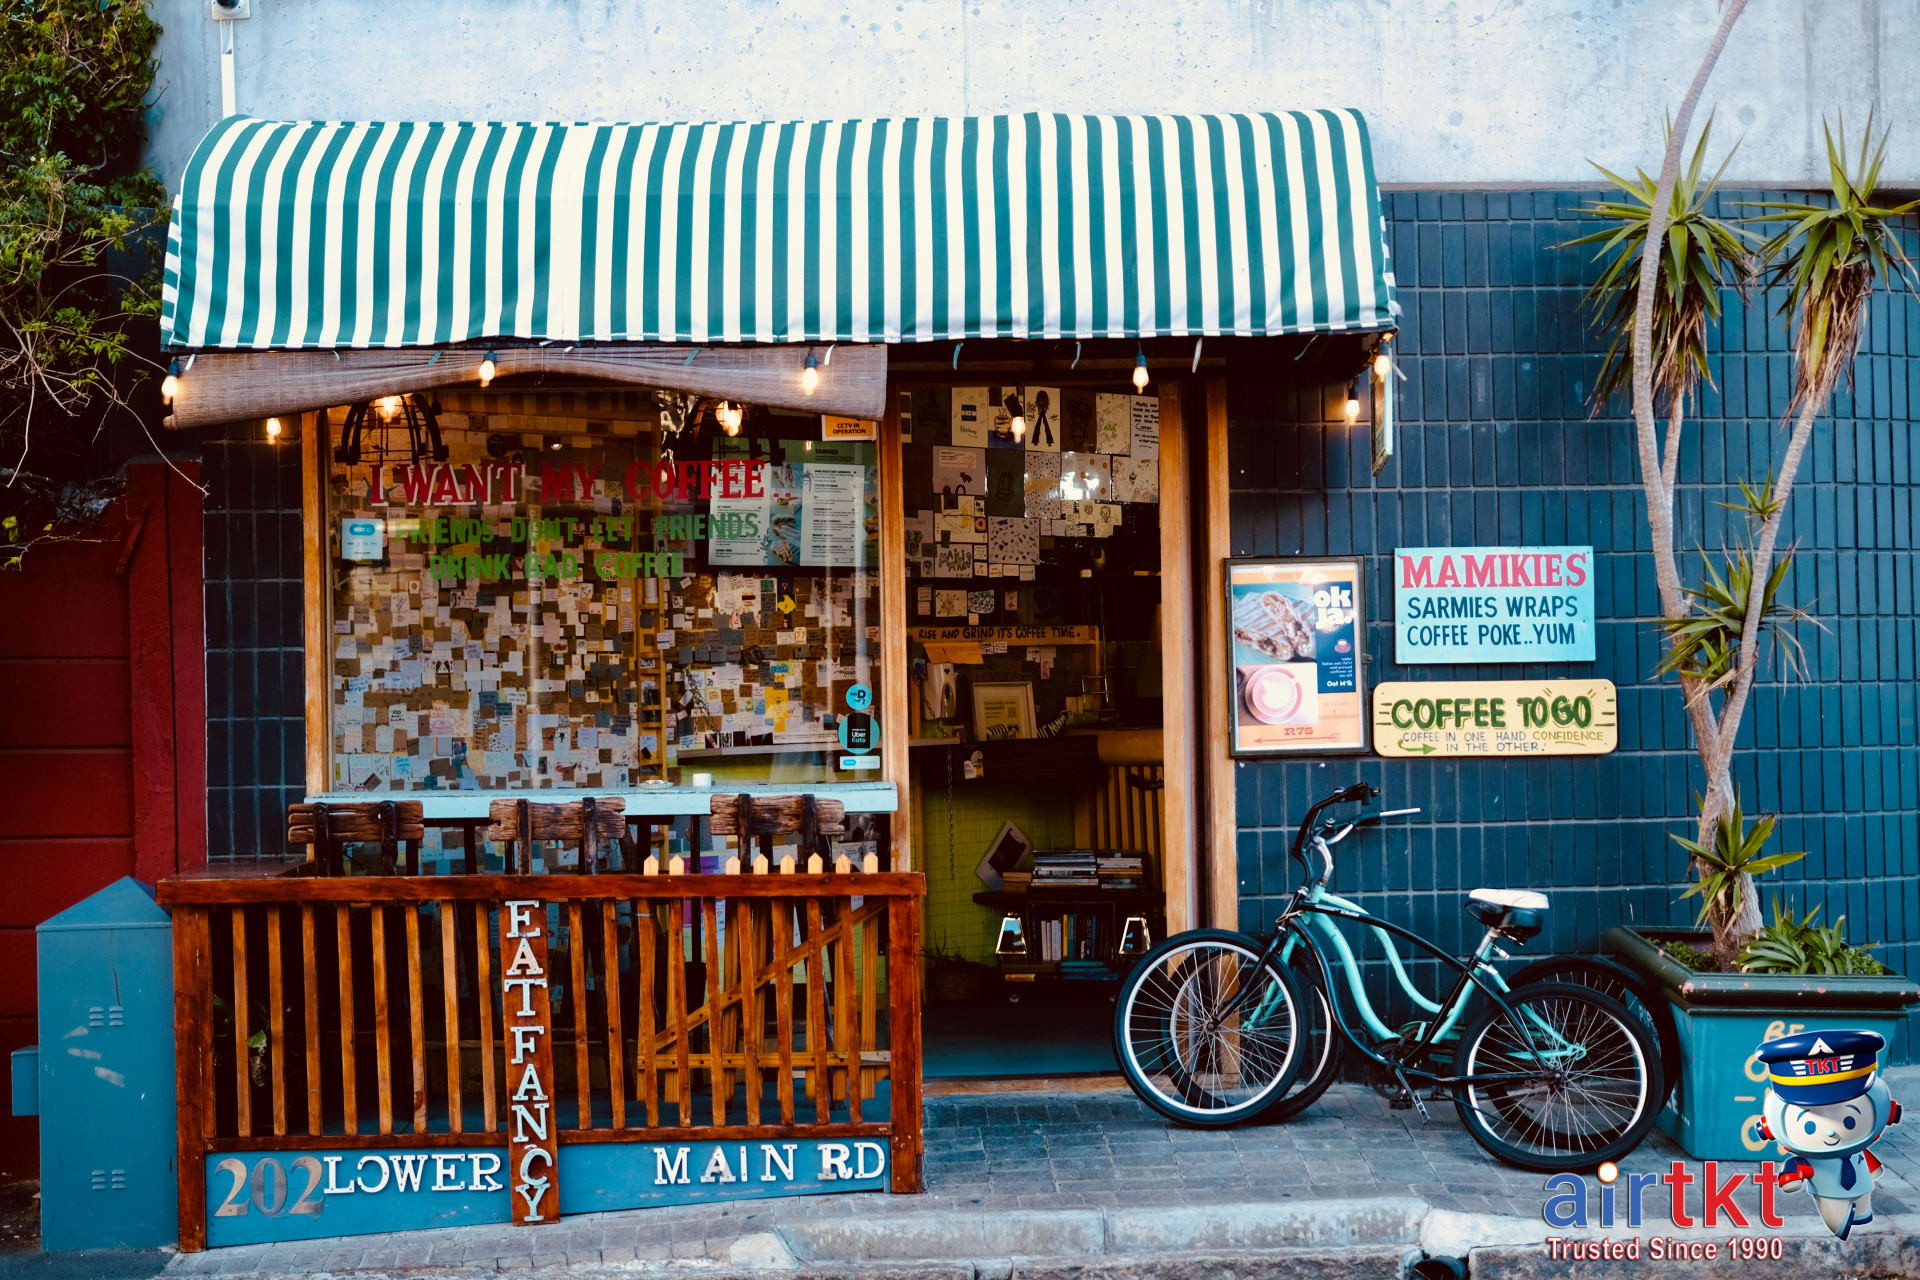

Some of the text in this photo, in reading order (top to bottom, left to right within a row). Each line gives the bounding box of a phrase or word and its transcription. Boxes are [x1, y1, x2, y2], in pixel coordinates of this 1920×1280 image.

[369, 463, 389, 506] I
[393, 462, 525, 506] WANT
[541, 463, 599, 502] MY
[395, 518, 495, 543] FRIENDS
[593, 516, 634, 542] LET
[655, 512, 759, 540] FRIENDS
[430, 552, 684, 580] DRINK BAD COFFEE
[1400, 552, 1587, 589] MAMIKIES
[1313, 586, 1352, 607] ok
[1407, 595, 1578, 619] SARMIES WRAPS
[918, 629, 937, 640] RISE
[941, 629, 960, 639] AND
[962, 627, 994, 639] GRIND
[1015, 626, 1046, 639] COFFEE
[1407, 625, 1469, 646] COFFEE
[1391, 698, 1507, 730] COFFEE
[1284, 727, 1314, 736] R75
[1402, 730, 1604, 742] COFFEE IN ONE HAND CONFIDENCE
[1446, 742, 1459, 752] IN
[1467, 742, 1489, 751] THE
[214, 1156, 326, 1217] 202
[653, 1143, 798, 1185] MAIN
[817, 1142, 886, 1180] RD
